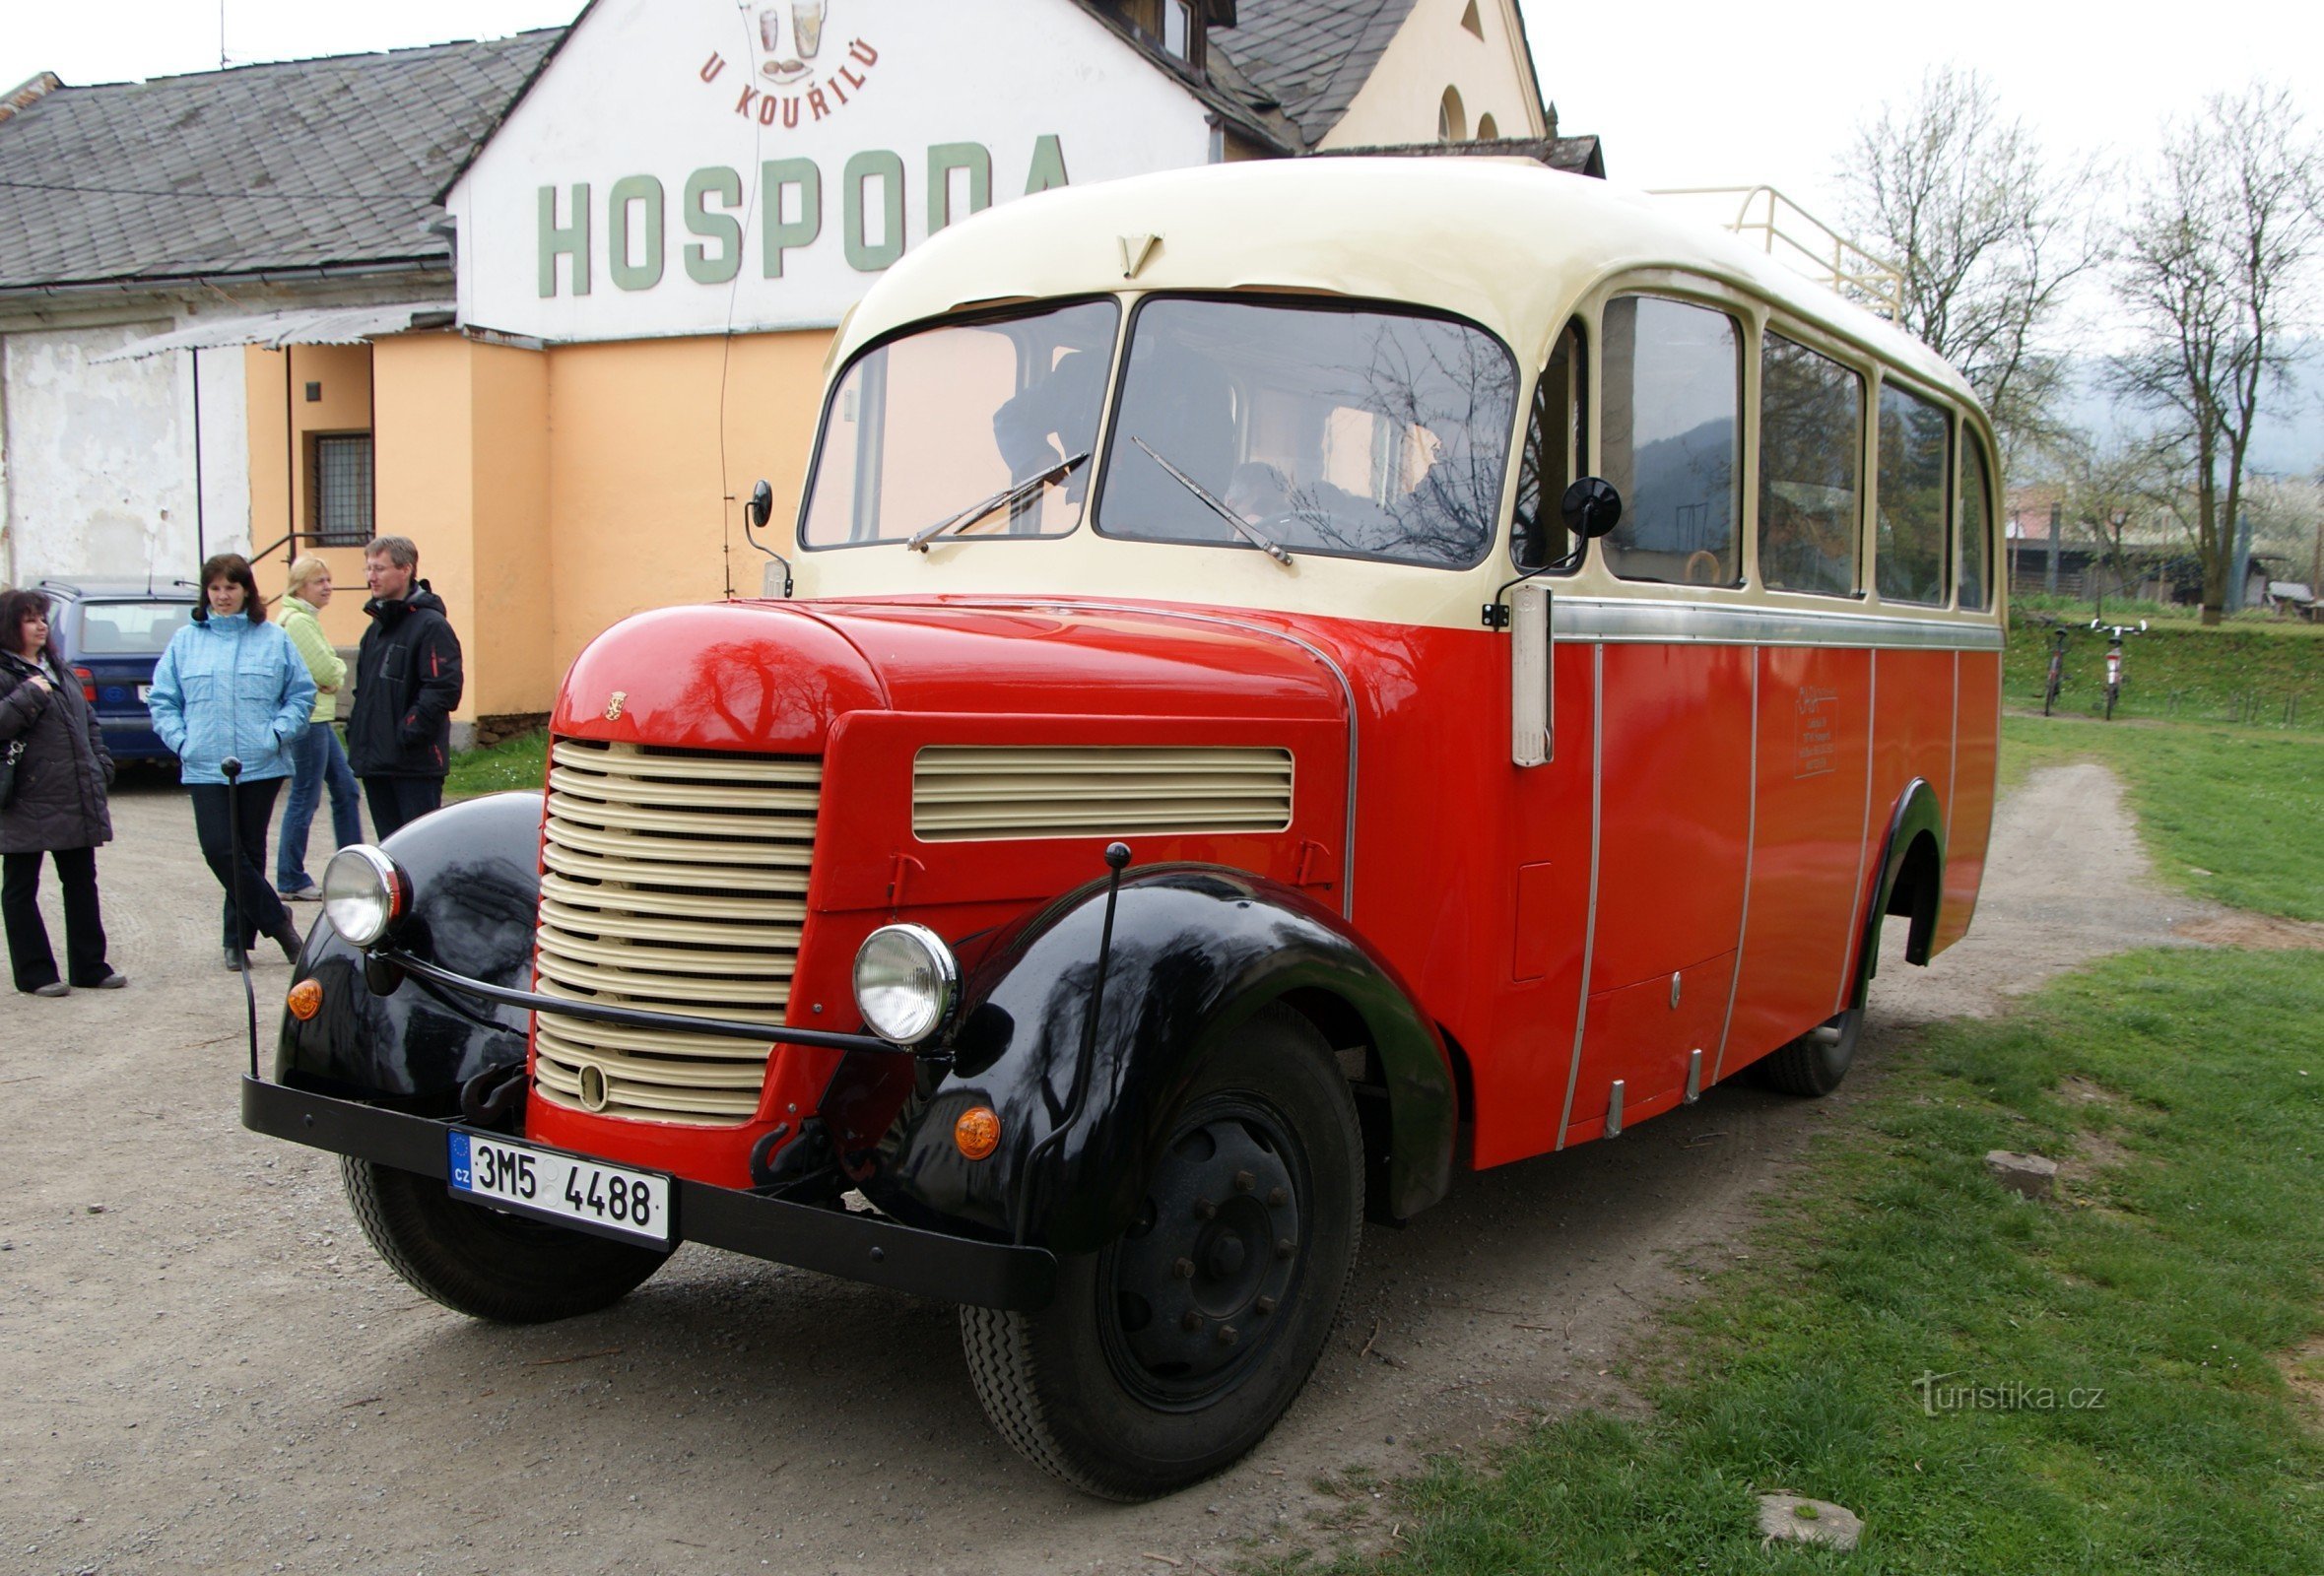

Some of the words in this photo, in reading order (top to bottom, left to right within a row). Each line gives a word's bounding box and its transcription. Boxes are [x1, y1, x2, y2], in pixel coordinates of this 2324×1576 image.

[699, 50, 727, 84] U
[454, 1167, 471, 1184] CZ
[477, 1145, 537, 1200] 3M5
[564, 1165, 650, 1226] 4488
